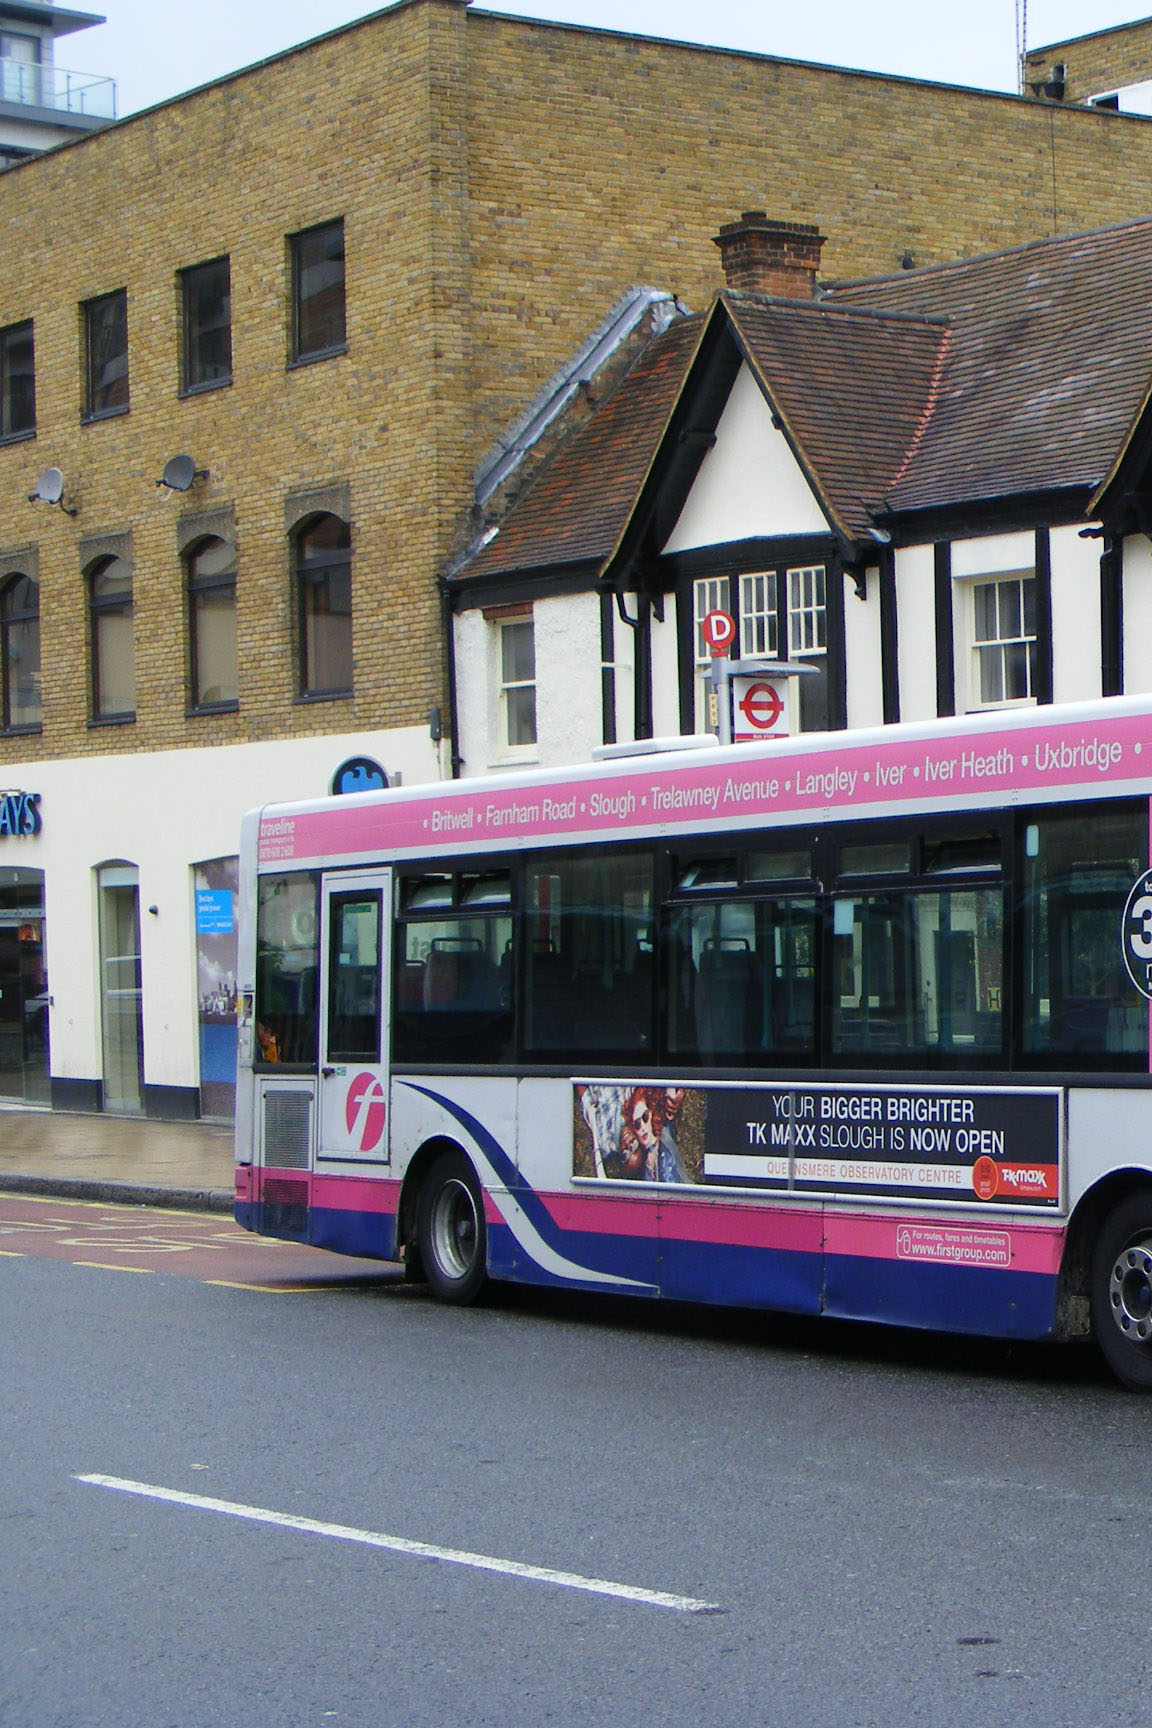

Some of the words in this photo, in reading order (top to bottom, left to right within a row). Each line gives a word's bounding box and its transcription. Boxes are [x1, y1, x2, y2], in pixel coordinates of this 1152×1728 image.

[711, 615, 731, 641] D
[431, 807, 474, 832] Britwell
[486, 803, 539, 826] Farnham
[542, 796, 576, 821] Road
[590, 790, 635, 819] Slough
[651, 786, 720, 811] Trelawney
[723, 778, 780, 802] Avenue
[796, 770, 857, 799] Langley
[875, 761, 907, 787] Iver
[924, 755, 957, 781] Iver
[961, 751, 1014, 778] Heath
[1035, 739, 1122, 773] Uxbridge
[773, 1095, 815, 1118] YOUR
[821, 1096, 882, 1120] BIGGER
[887, 1098, 974, 1123] BRIGHTER
[747, 1122, 767, 1144] TK
[771, 1123, 816, 1147] MAXX
[820, 1125, 885, 1149] SLOUGH
[890, 1126, 905, 1150] IS
[910, 1127, 951, 1151] NOW
[955, 1129, 1005, 1154] OPEN
[767, 1161, 836, 1178] QUENSMERE
[840, 1165, 914, 1181] OBSERVATORY
[918, 1169, 962, 1184] CENTRE
[912, 1230, 923, 1240] For
[945, 1233, 960, 1242] fares
[961, 1234, 973, 1243] and
[974, 1235, 1006, 1246] timetables
[911, 1243, 1007, 1262] www.firstgroup.com
